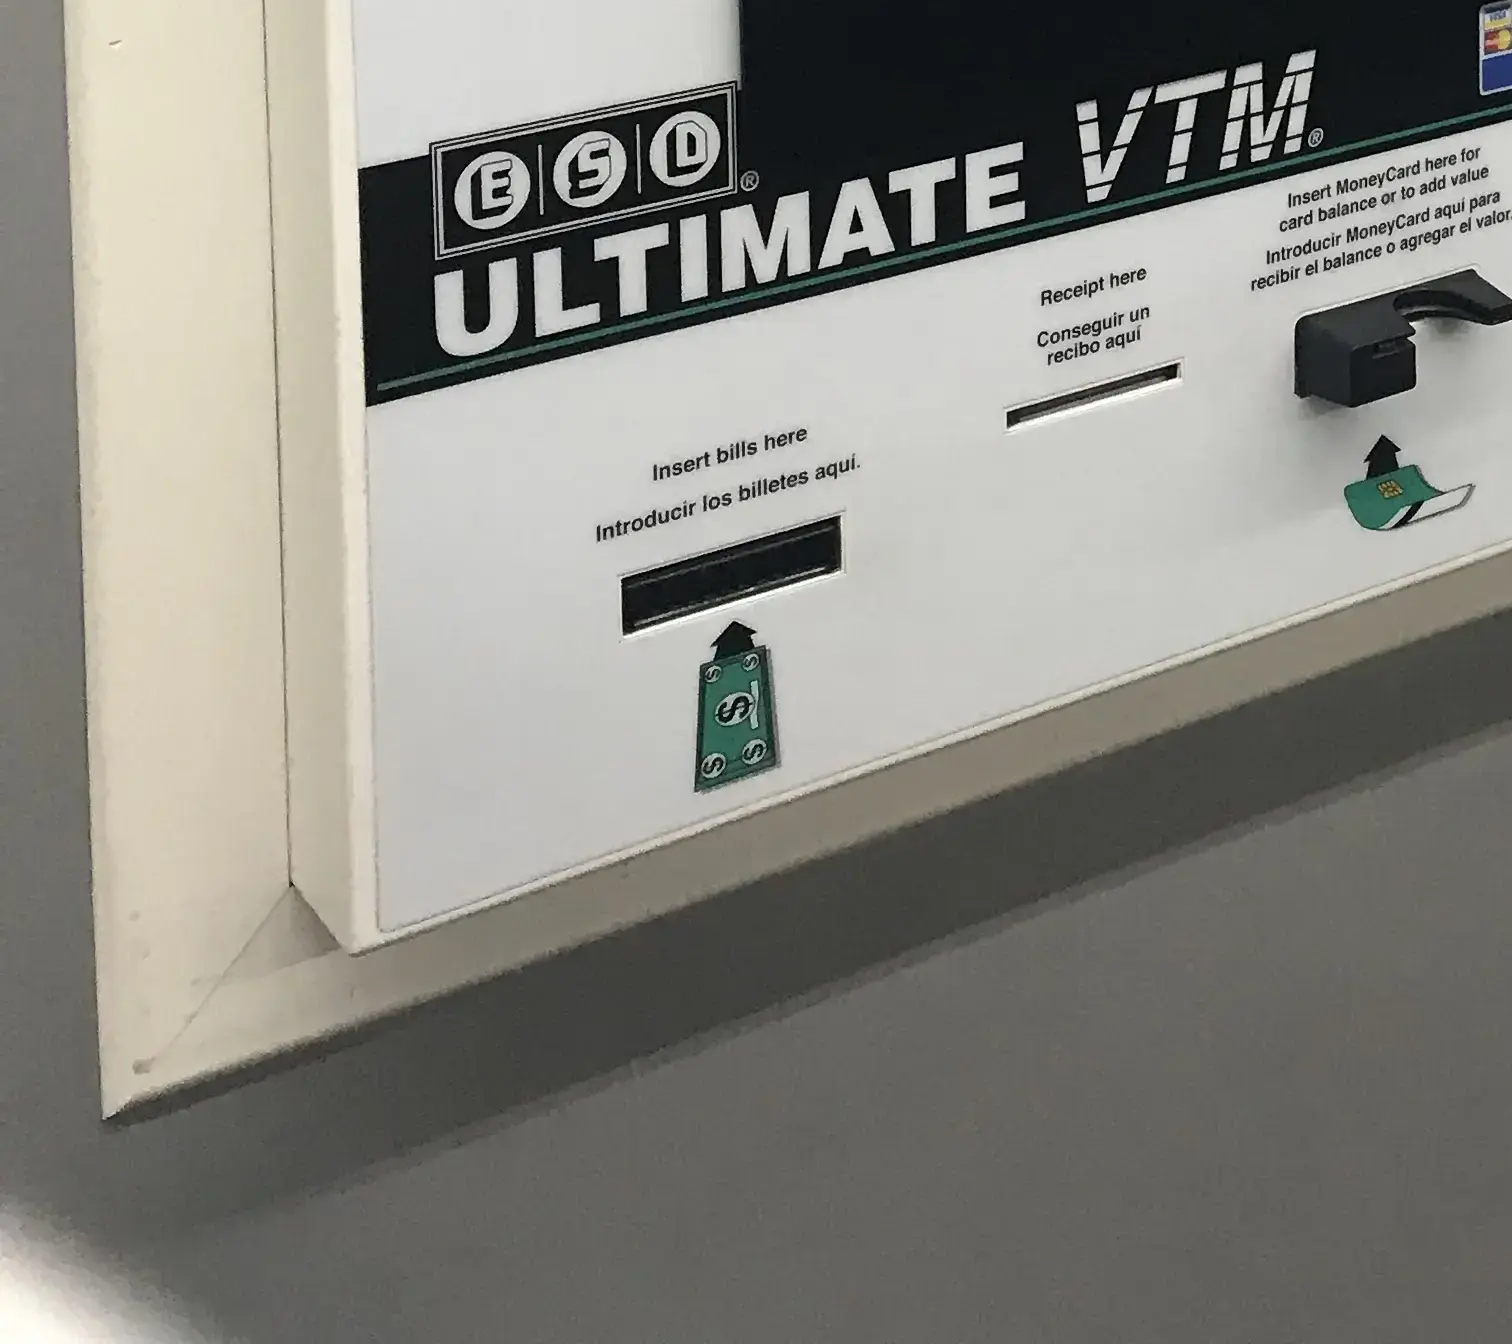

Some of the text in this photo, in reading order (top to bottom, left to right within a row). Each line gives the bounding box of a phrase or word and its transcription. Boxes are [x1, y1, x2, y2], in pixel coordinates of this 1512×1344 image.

[435, 50, 1319, 356] ULTIMATE VTM
[1280, 167, 1488, 232] card balance add value
[1288, 148, 1480, 208] Insert MoneyCard here for
[1251, 210, 1512, 291] recibir balance agregar valor.
[1267, 233, 1341, 264] Introducir
[1347, 207, 1429, 243] MoneyCard
[1470, 192, 1500, 213] para
[1041, 268, 1146, 306] Receipt here
[1037, 307, 1149, 347] Conseguir un
[1048, 341, 1100, 365] recibo
[654, 429, 807, 480] Insert bills here
[597, 501, 696, 542] Introducir
[703, 493, 732, 512] los
[739, 471, 808, 501] billetes
